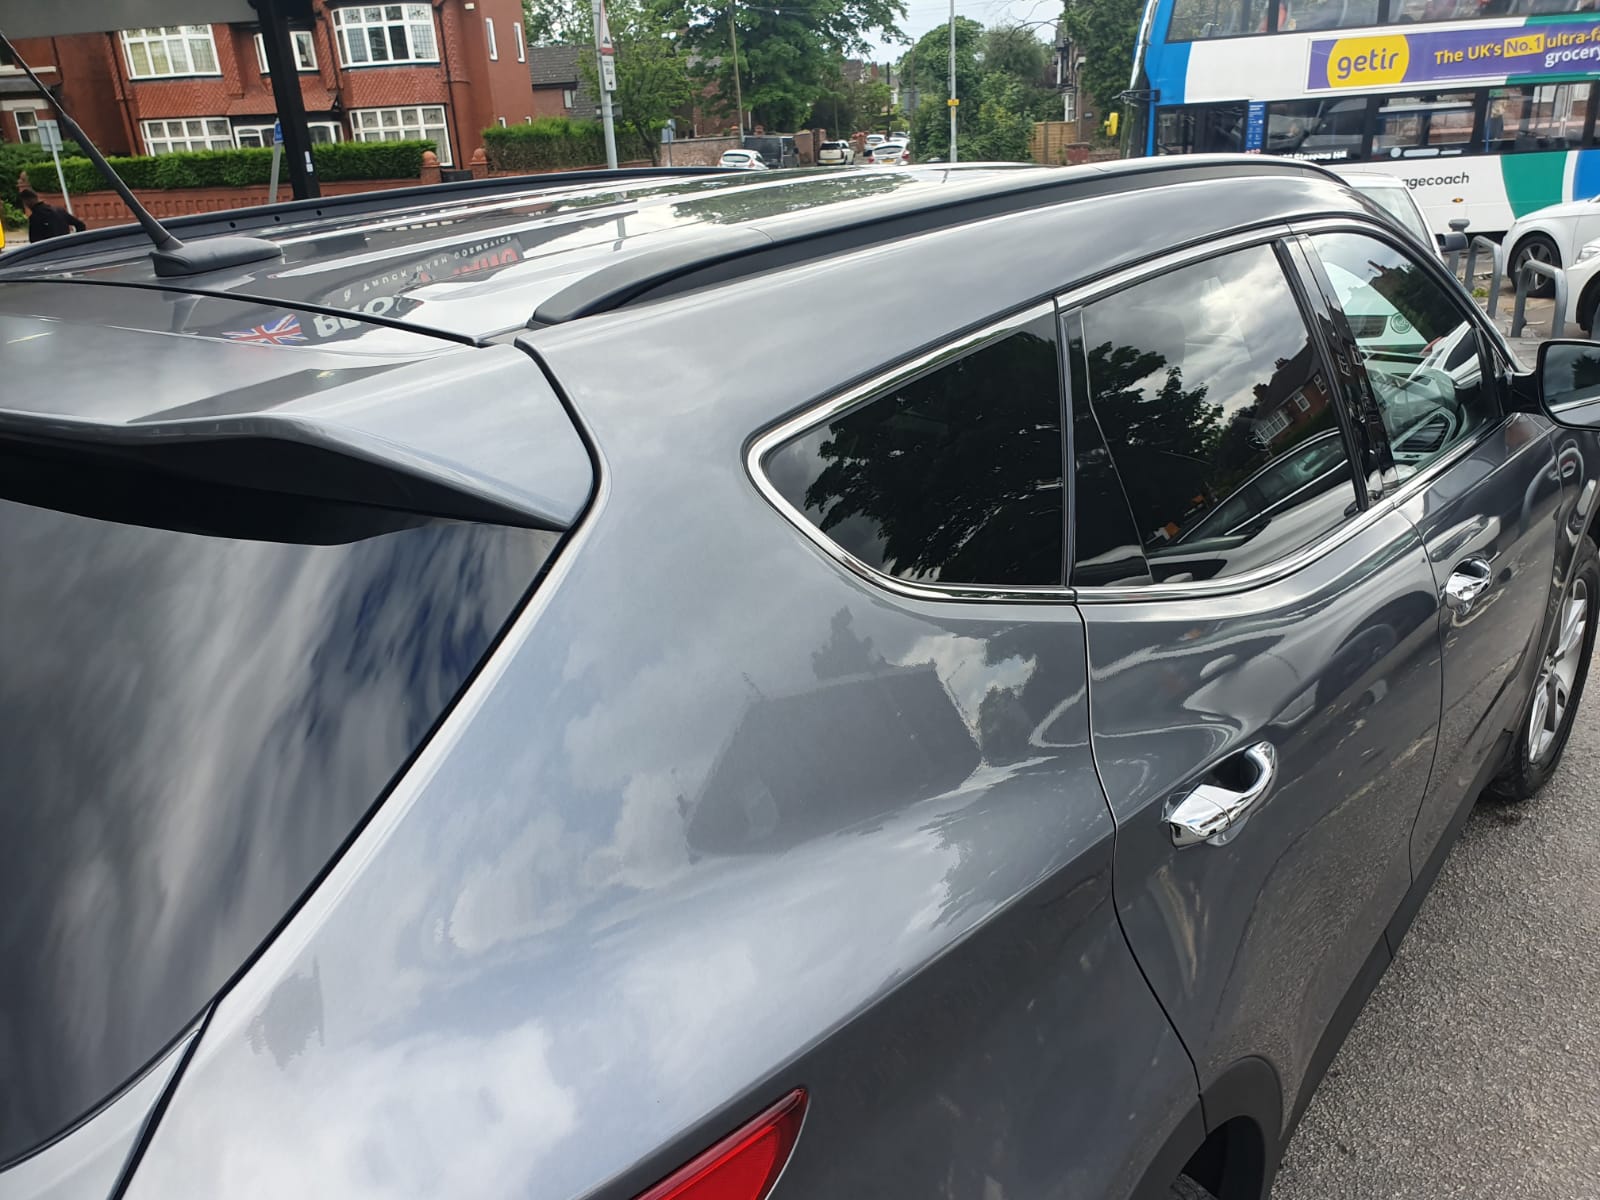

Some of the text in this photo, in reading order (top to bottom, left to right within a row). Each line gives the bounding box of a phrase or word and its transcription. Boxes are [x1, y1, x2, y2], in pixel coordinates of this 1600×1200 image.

[1337, 48, 1399, 80] getir
[1434, 49, 1464, 65] The
[1468, 43, 1502, 60] UK's
